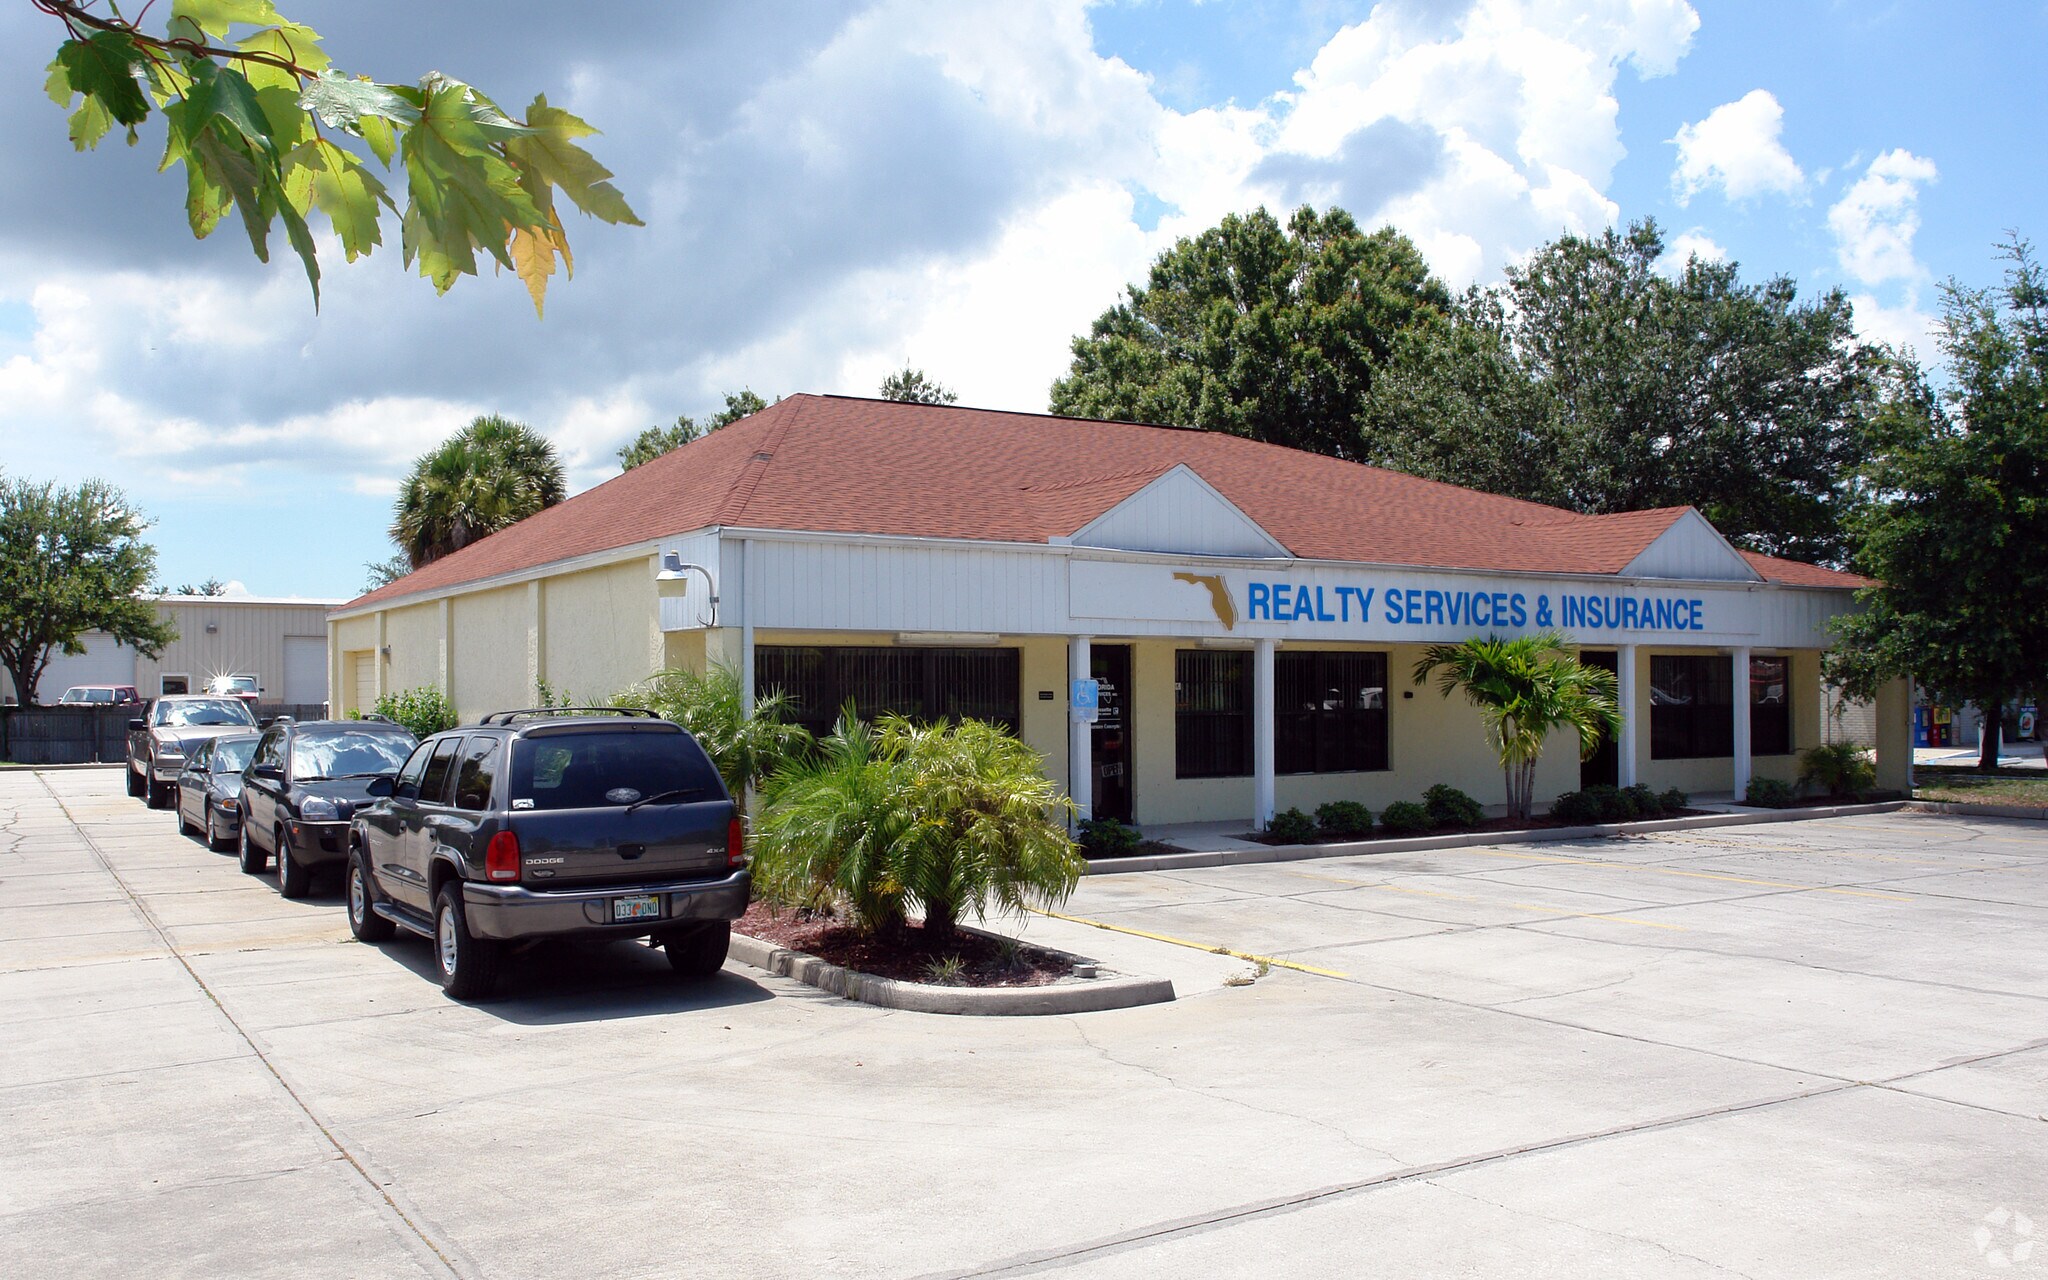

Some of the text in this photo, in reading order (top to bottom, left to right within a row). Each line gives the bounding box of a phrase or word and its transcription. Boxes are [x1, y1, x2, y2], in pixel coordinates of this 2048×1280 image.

[1248, 581, 1705, 630] REALTY SERVICES & INSURANCE
[525, 857, 565, 865] DODGE
